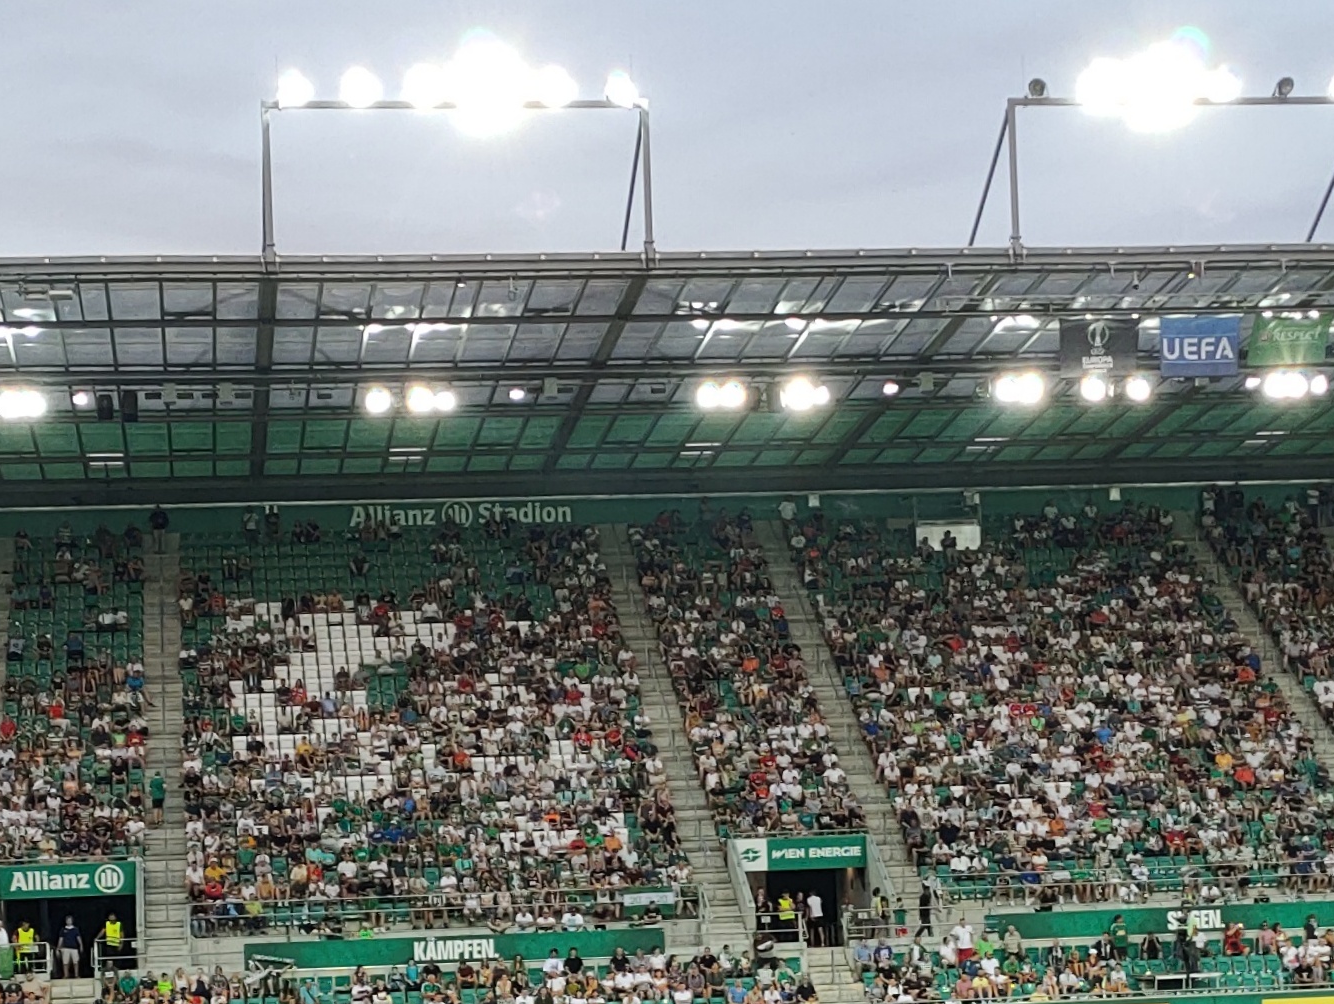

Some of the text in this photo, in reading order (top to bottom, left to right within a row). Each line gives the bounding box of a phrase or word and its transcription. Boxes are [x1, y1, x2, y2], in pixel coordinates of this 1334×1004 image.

[1163, 336, 1234, 360] UEFA
[349, 502, 572, 528] Allianz Stadion
[771, 845, 862, 861] WIEN ENERGIE
[10, 870, 91, 892] Allianz
[413, 936, 500, 961] KÄMPFEN.
